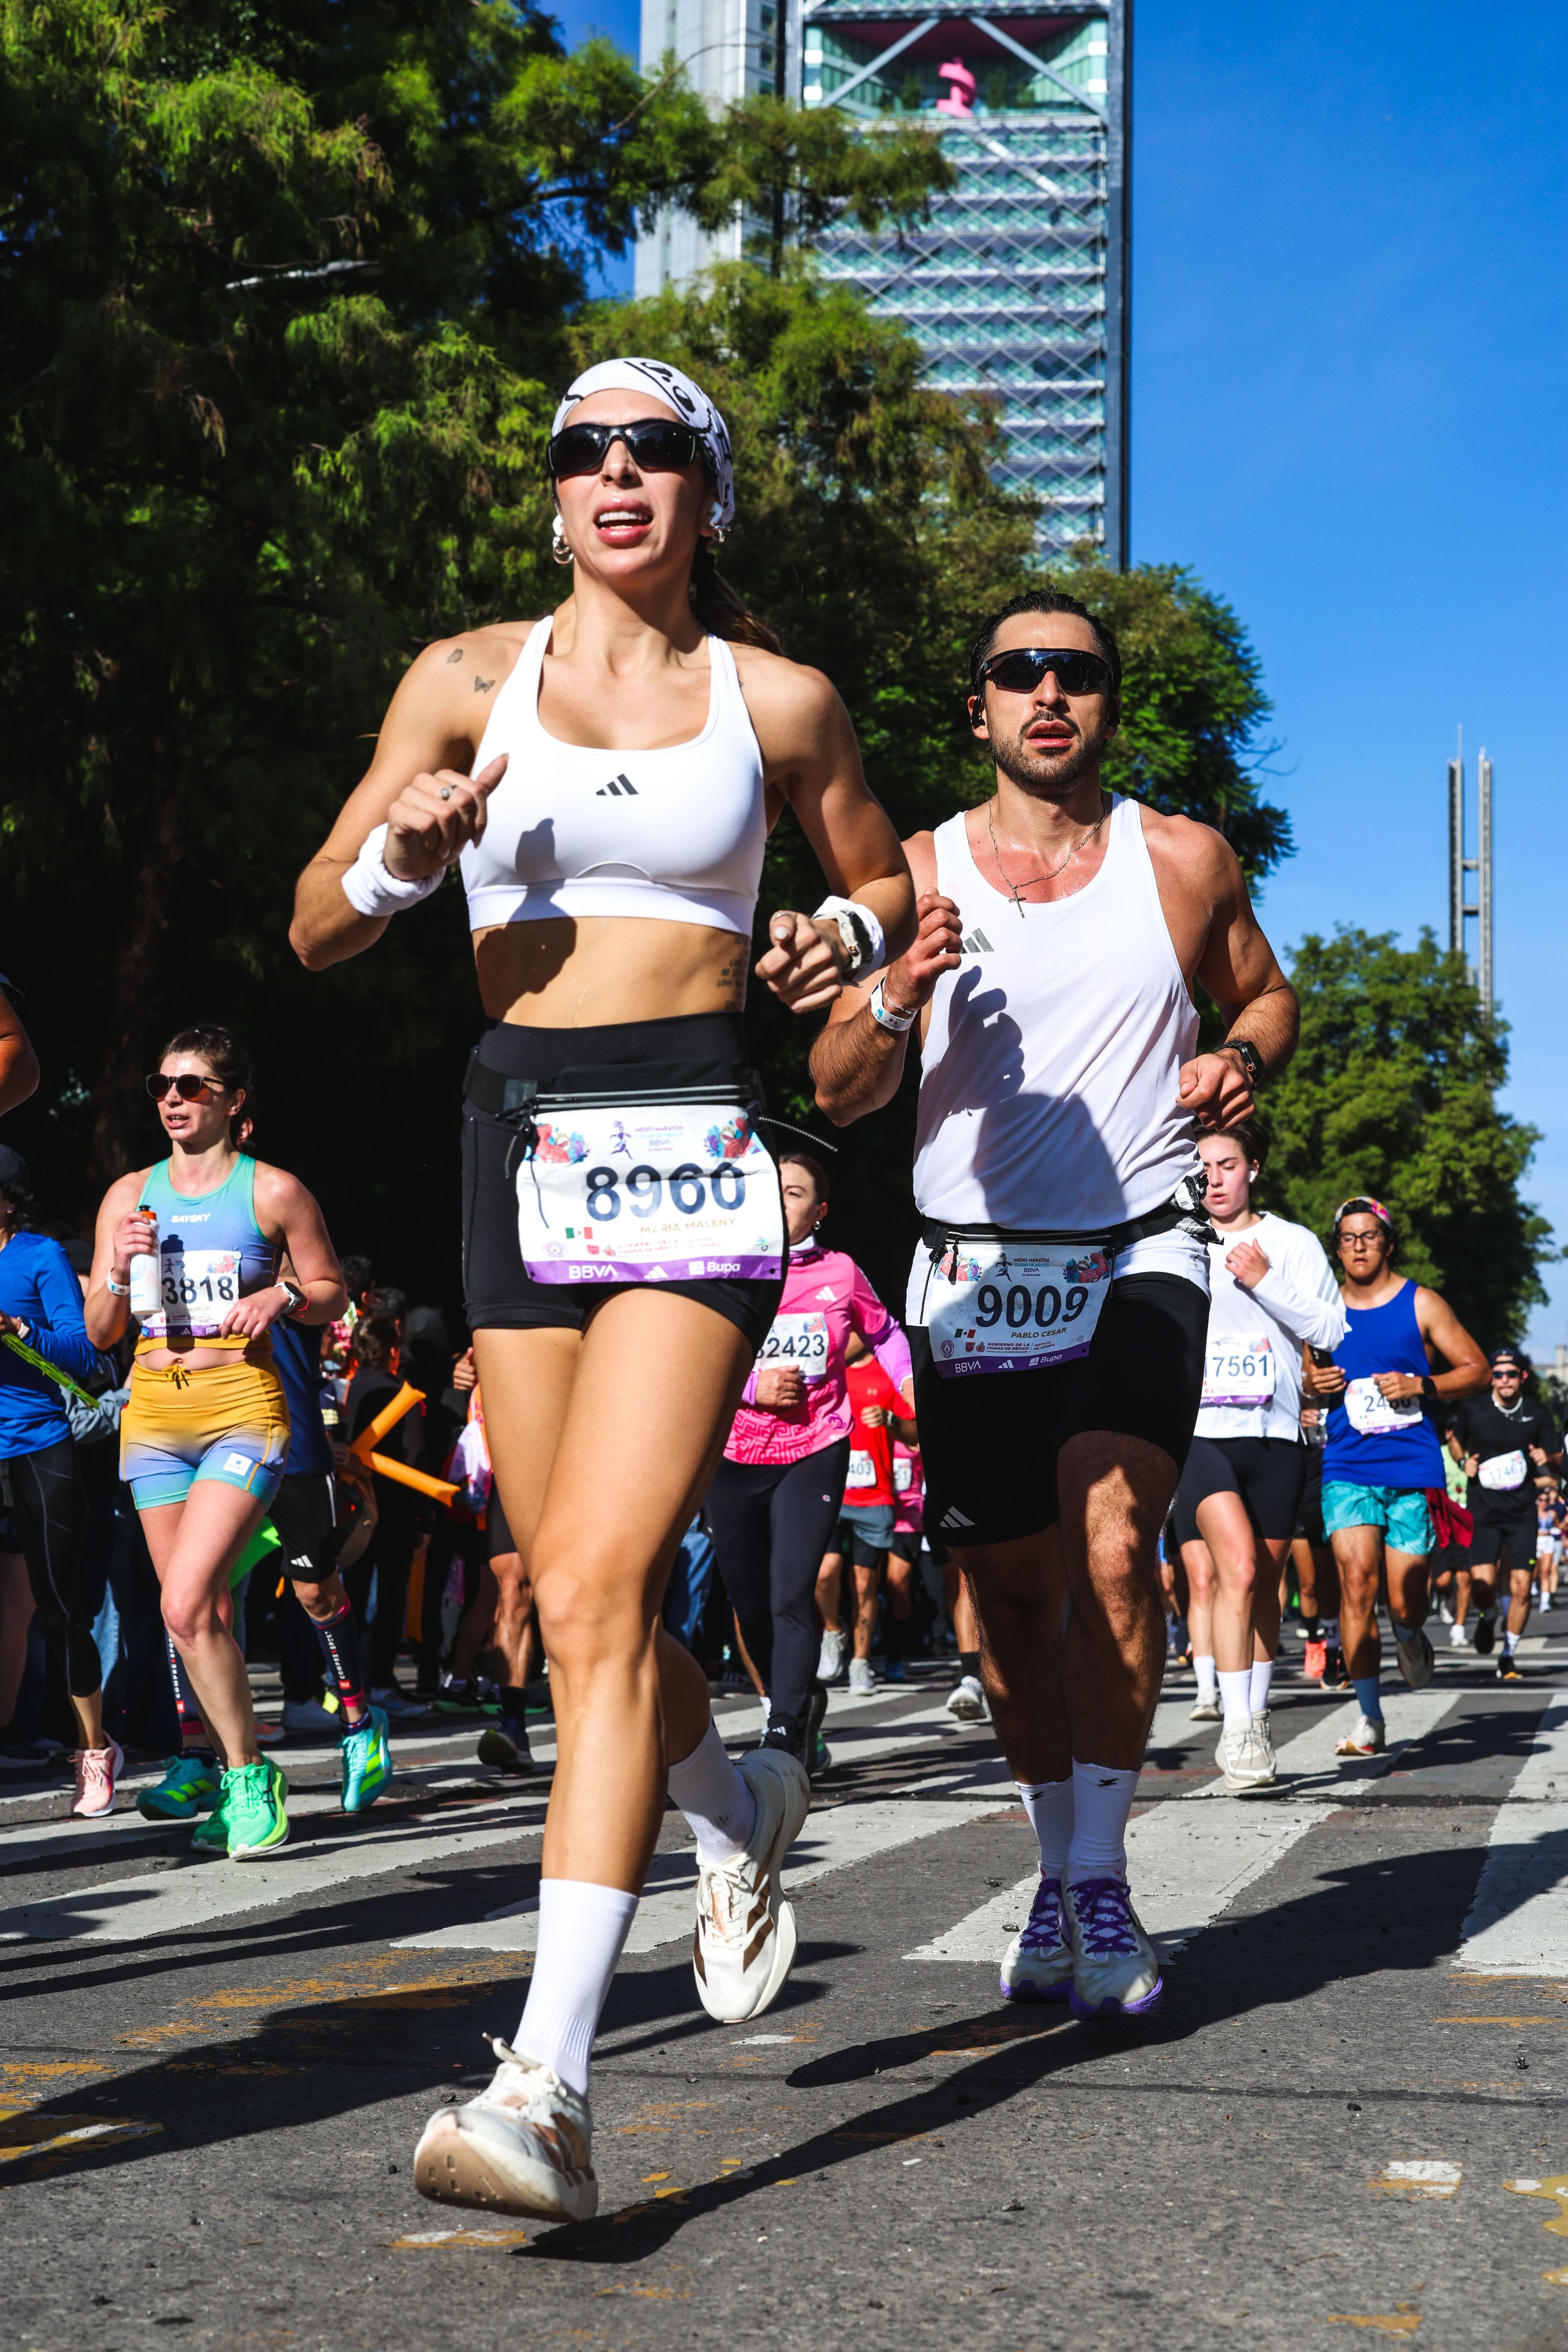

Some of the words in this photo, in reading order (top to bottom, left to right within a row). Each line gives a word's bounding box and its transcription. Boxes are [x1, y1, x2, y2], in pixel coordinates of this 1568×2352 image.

[586, 1162, 746, 1221] 8960
[171, 1213, 211, 1223] SAYSKY
[685, 1218, 735, 1229] MALENY
[569, 1264, 617, 1279] BBVA
[707, 1261, 740, 1273] Bupa
[161, 1276, 234, 1305] 3818
[976, 1285, 1089, 1328] 9009
[1041, 1327, 1067, 1337] CESAR
[1040, 1354, 1062, 1363] Bupa
[955, 1360, 981, 1373] BBVA
[168, 1635, 180, 1699] COMPRESSPOR
